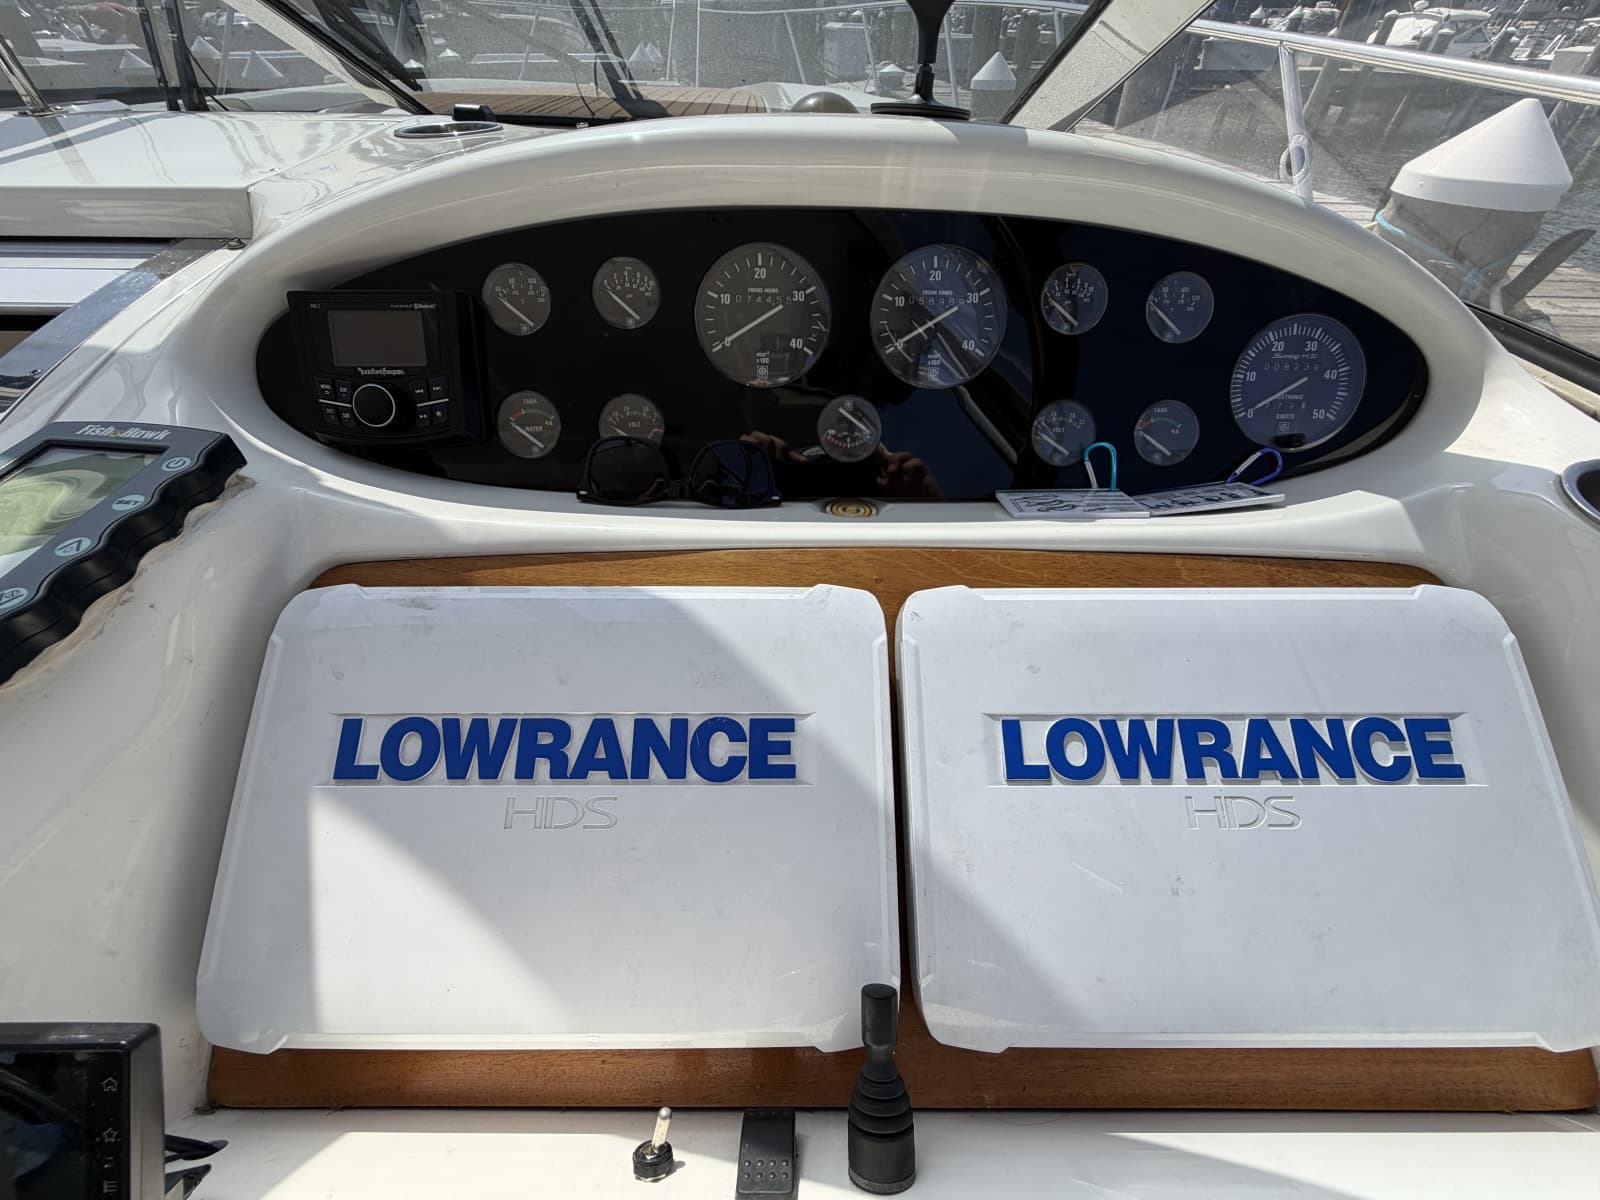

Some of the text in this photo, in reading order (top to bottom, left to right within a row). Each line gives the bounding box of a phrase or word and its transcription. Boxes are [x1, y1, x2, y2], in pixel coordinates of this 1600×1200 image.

[754, 267, 767, 279] 20
[929, 270, 942, 281] 20
[720, 293, 731, 305] 10
[792, 290, 805, 302] 30
[894, 296, 905, 307] 10
[966, 292, 979, 304] 30
[790, 338, 803, 349] 40
[962, 340, 975, 350] 40
[1272, 341, 1285, 352] 20
[1304, 341, 1318, 352] 30
[1246, 371, 1257, 382] 10
[1323, 369, 1338, 380] 40
[1247, 409, 1254, 418] 0
[1312, 409, 1326, 419] 50
[332, 716, 797, 783] LOWRANCE
[1001, 717, 1466, 782] LOWRANCE
[503, 795, 619, 831] HDS
[1184, 795, 1304, 830] HDS
